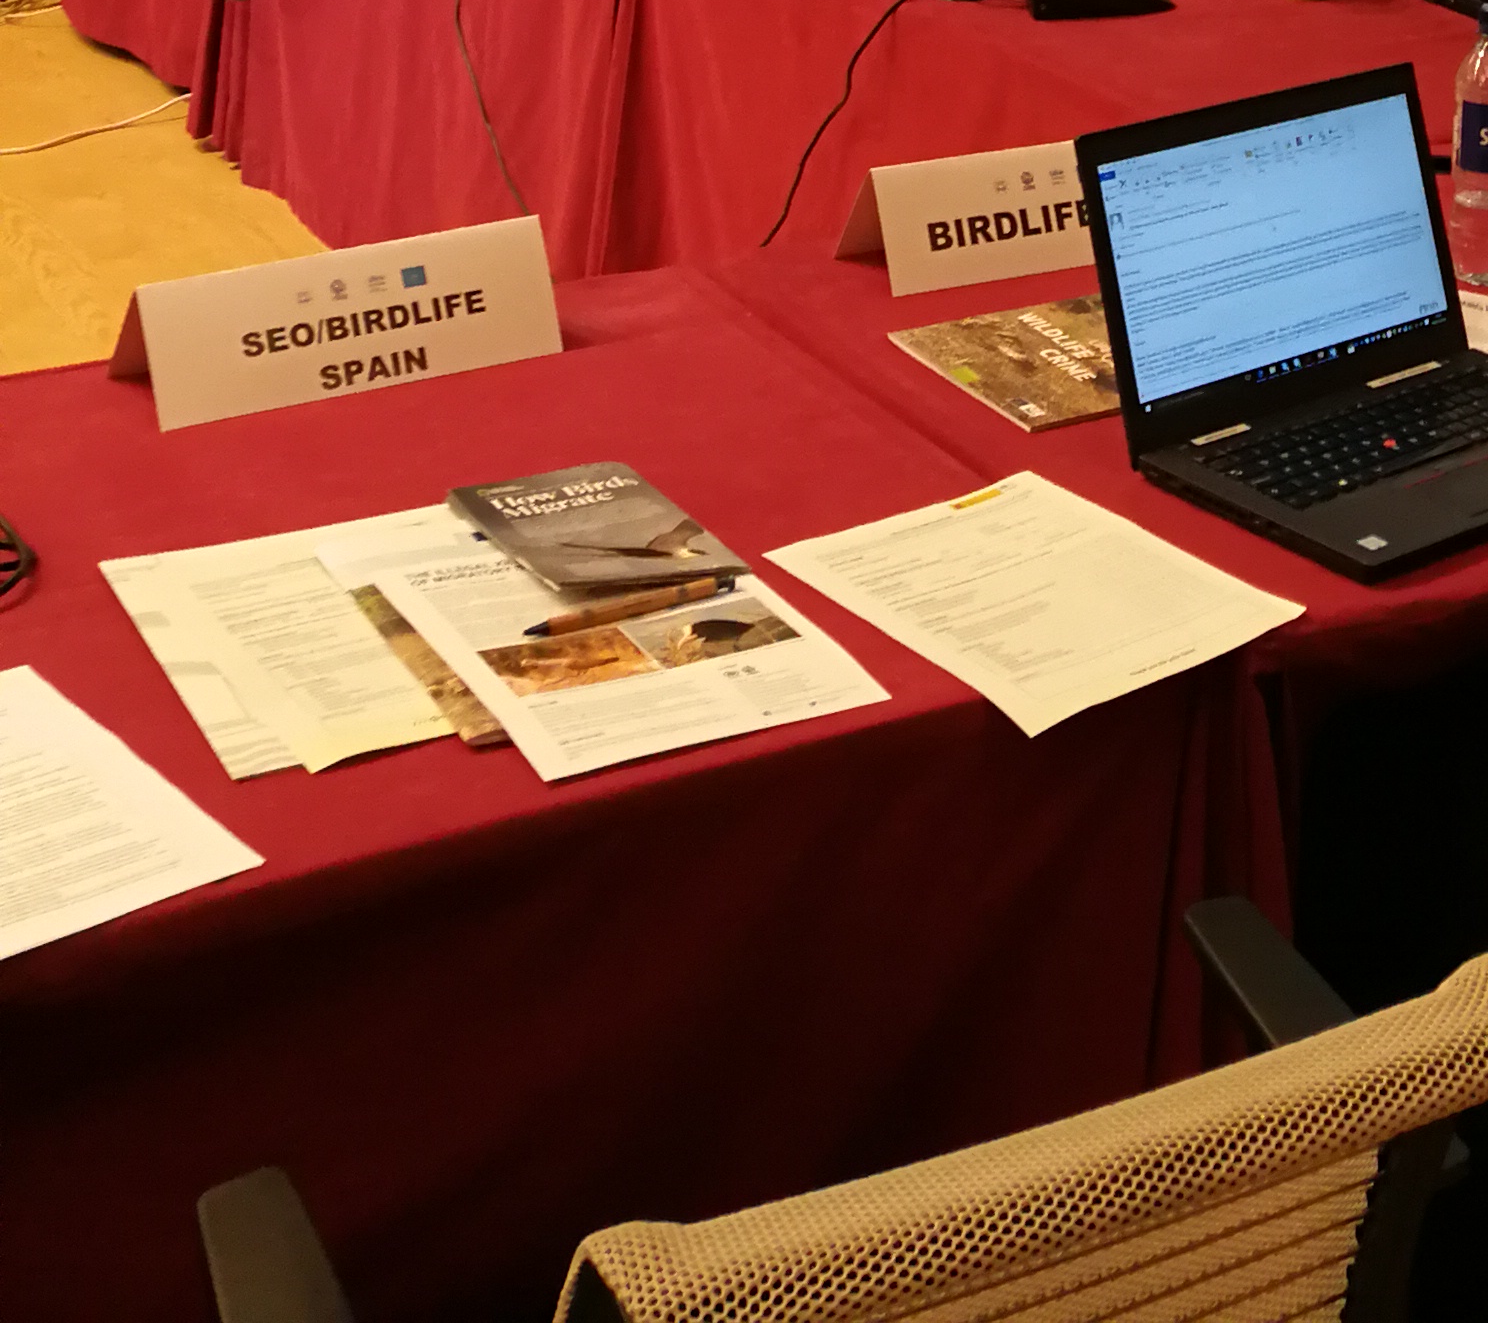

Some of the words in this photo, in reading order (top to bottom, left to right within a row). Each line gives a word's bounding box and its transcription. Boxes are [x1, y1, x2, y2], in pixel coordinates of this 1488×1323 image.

[926, 198, 1090, 253] BIRDLIFE
[240, 288, 487, 358] SEO/BIRDLIFE
[1017, 311, 1096, 360] WILDLIFE
[318, 346, 428, 391] SPAIN
[501, 490, 616, 520] Migrate
[560, 474, 640, 498] Birds
